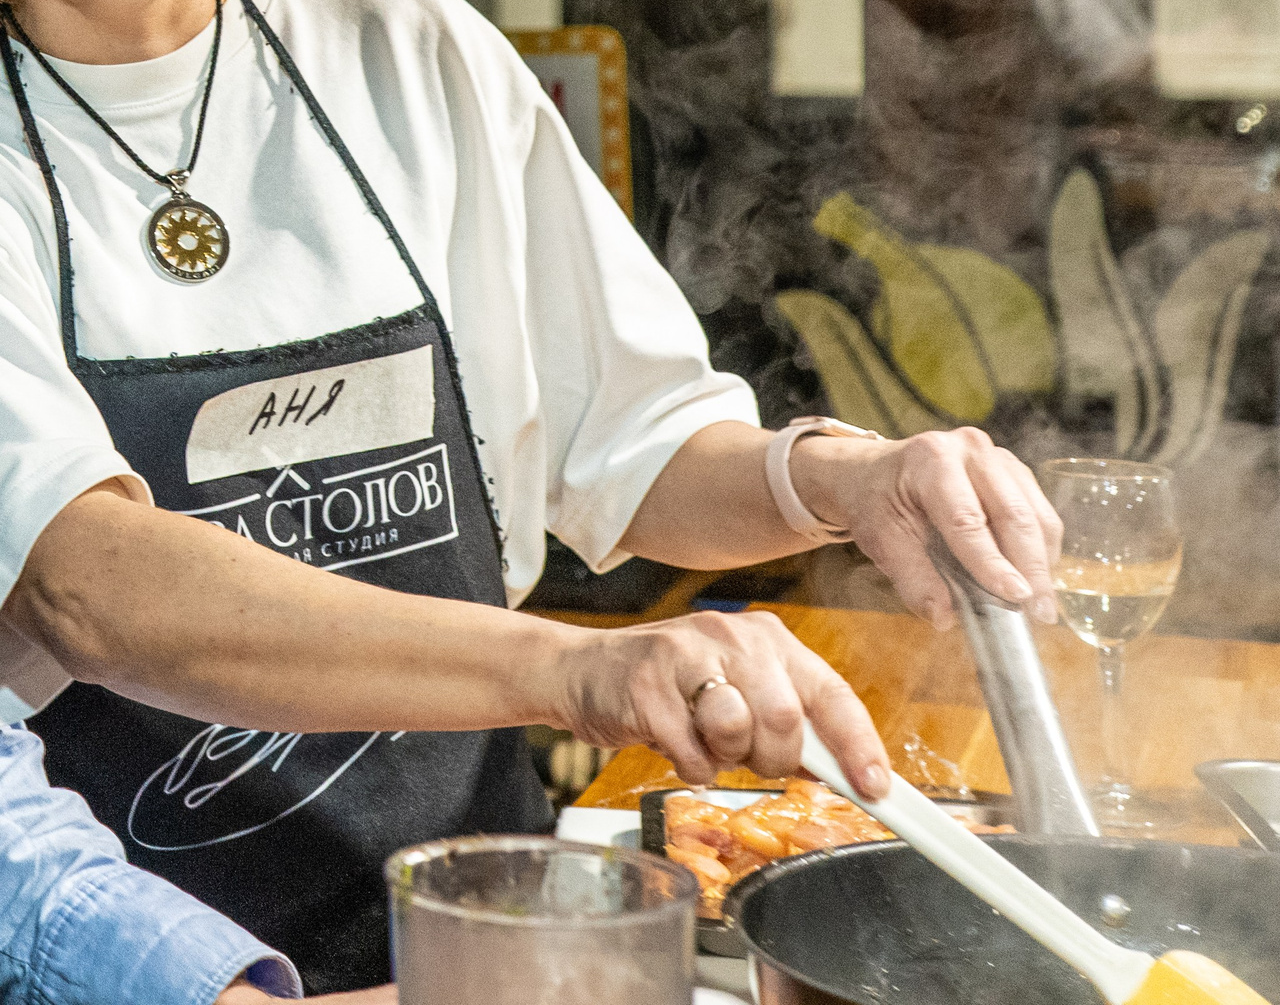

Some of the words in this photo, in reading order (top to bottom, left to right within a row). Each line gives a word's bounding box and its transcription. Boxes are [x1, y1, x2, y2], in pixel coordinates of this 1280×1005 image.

[248, 378, 345, 436] АНЯ
[265, 462, 443, 548] СТОЛОВ
[321, 528, 400, 558] СТУДИЯ
